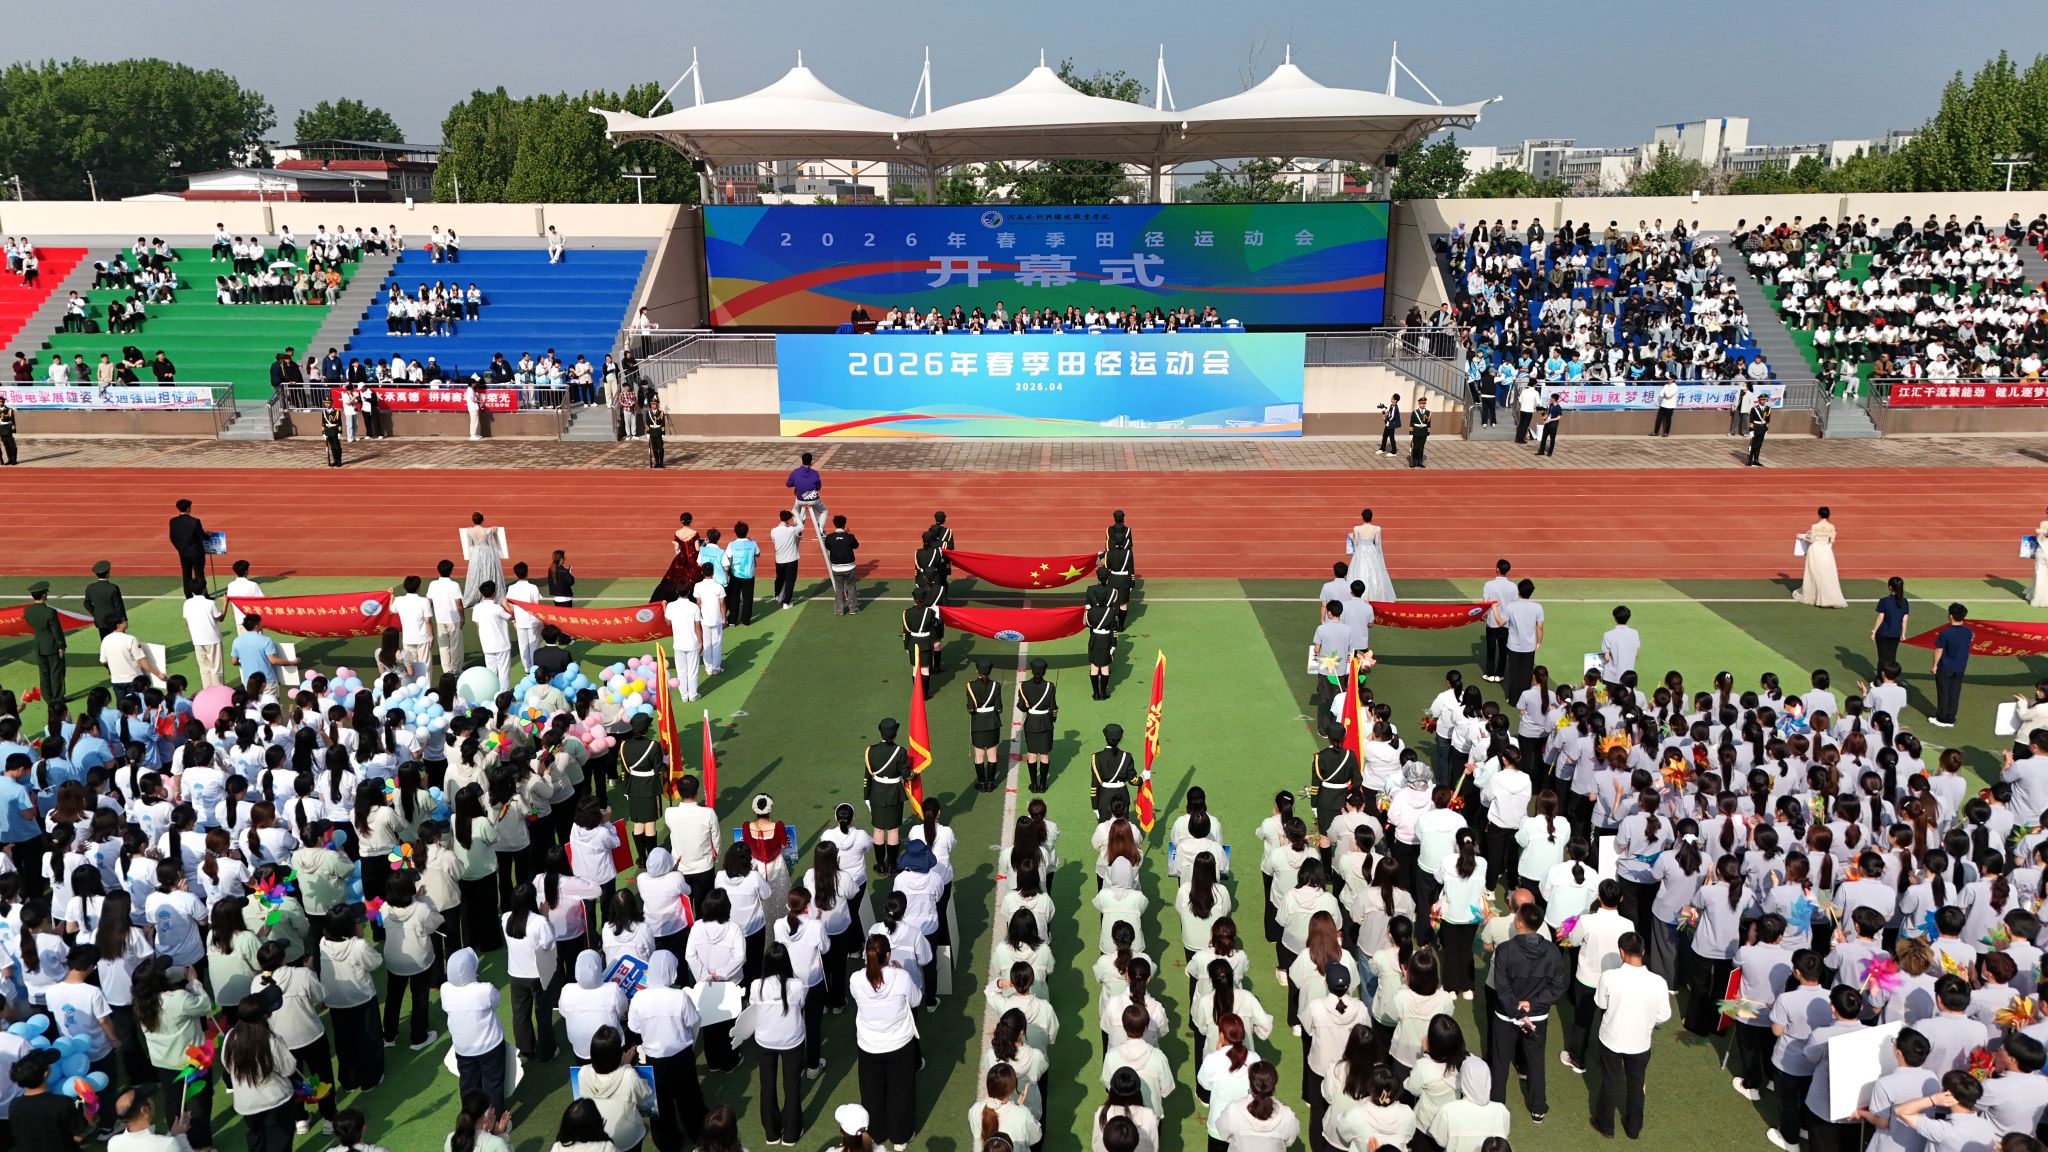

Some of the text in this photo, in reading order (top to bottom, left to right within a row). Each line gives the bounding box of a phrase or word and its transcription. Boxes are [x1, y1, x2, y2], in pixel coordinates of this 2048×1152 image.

[780, 229, 1314, 249] 2026年春季田径运动会
[926, 253, 1165, 288] 开幕式
[848, 350, 1231, 377] 2026年春季田径运动会
[1015, 382, 1064, 392] 2026.04
[1898, 386, 2048, 398] 江汇千流聚能劲 健儿逐梦
[103, 390, 199, 404] 交通强国担使命
[428, 391, 511, 403] 拼搏赛荣光
[1557, 389, 1656, 404] 交通铸就梦想
